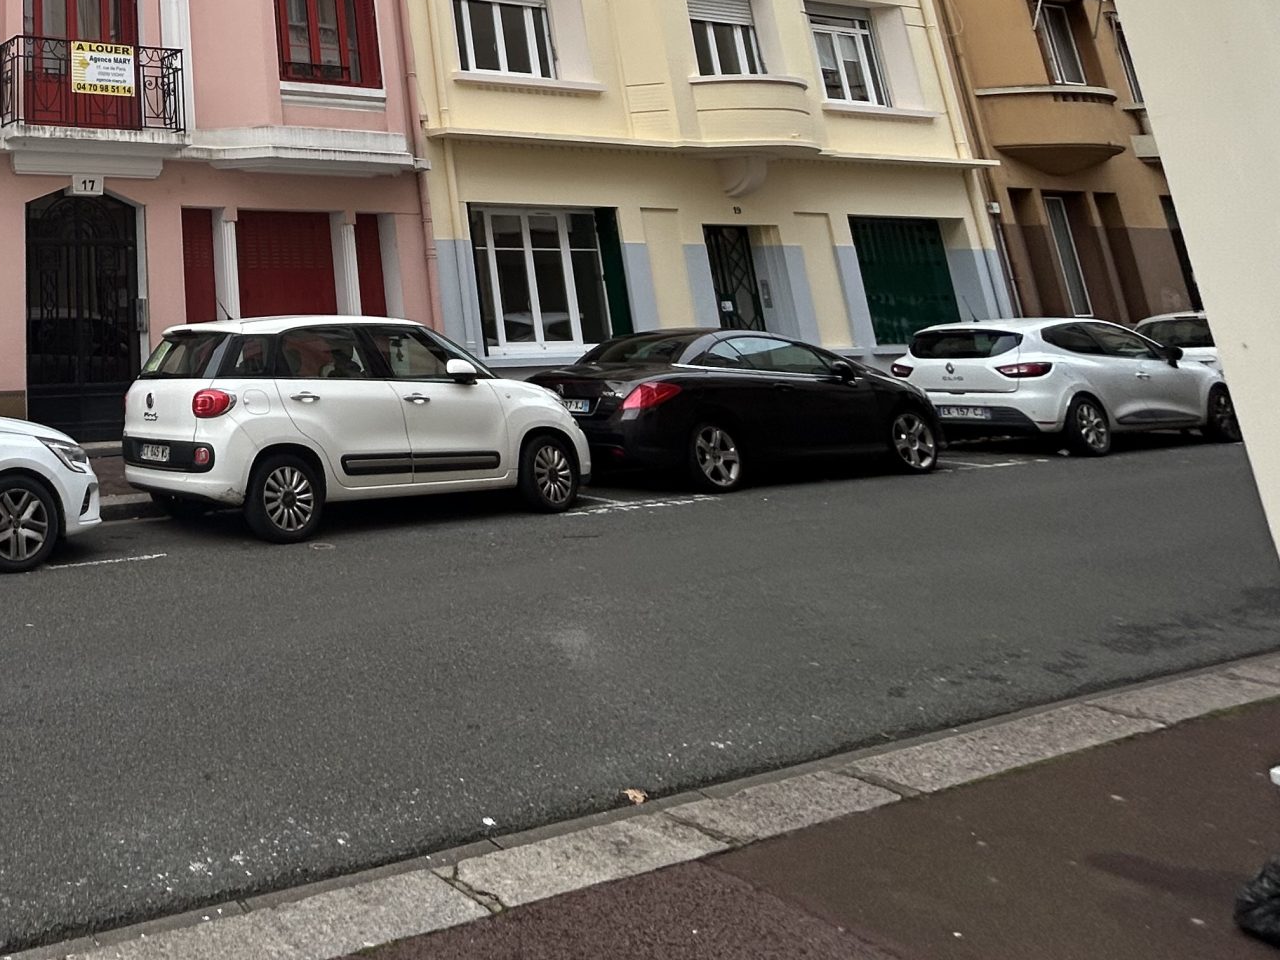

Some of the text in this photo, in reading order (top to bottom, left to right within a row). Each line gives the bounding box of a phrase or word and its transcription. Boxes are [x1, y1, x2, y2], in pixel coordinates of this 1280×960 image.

[88, 44, 130, 55] LOUER
[89, 55, 131, 65] Agence MARY
[76, 83, 132, 94] 04 70 98 51 14
[81, 179, 95, 191] 17
[733, 206, 741, 215] 19
[563, 400, 584, 410] 37-XJ
